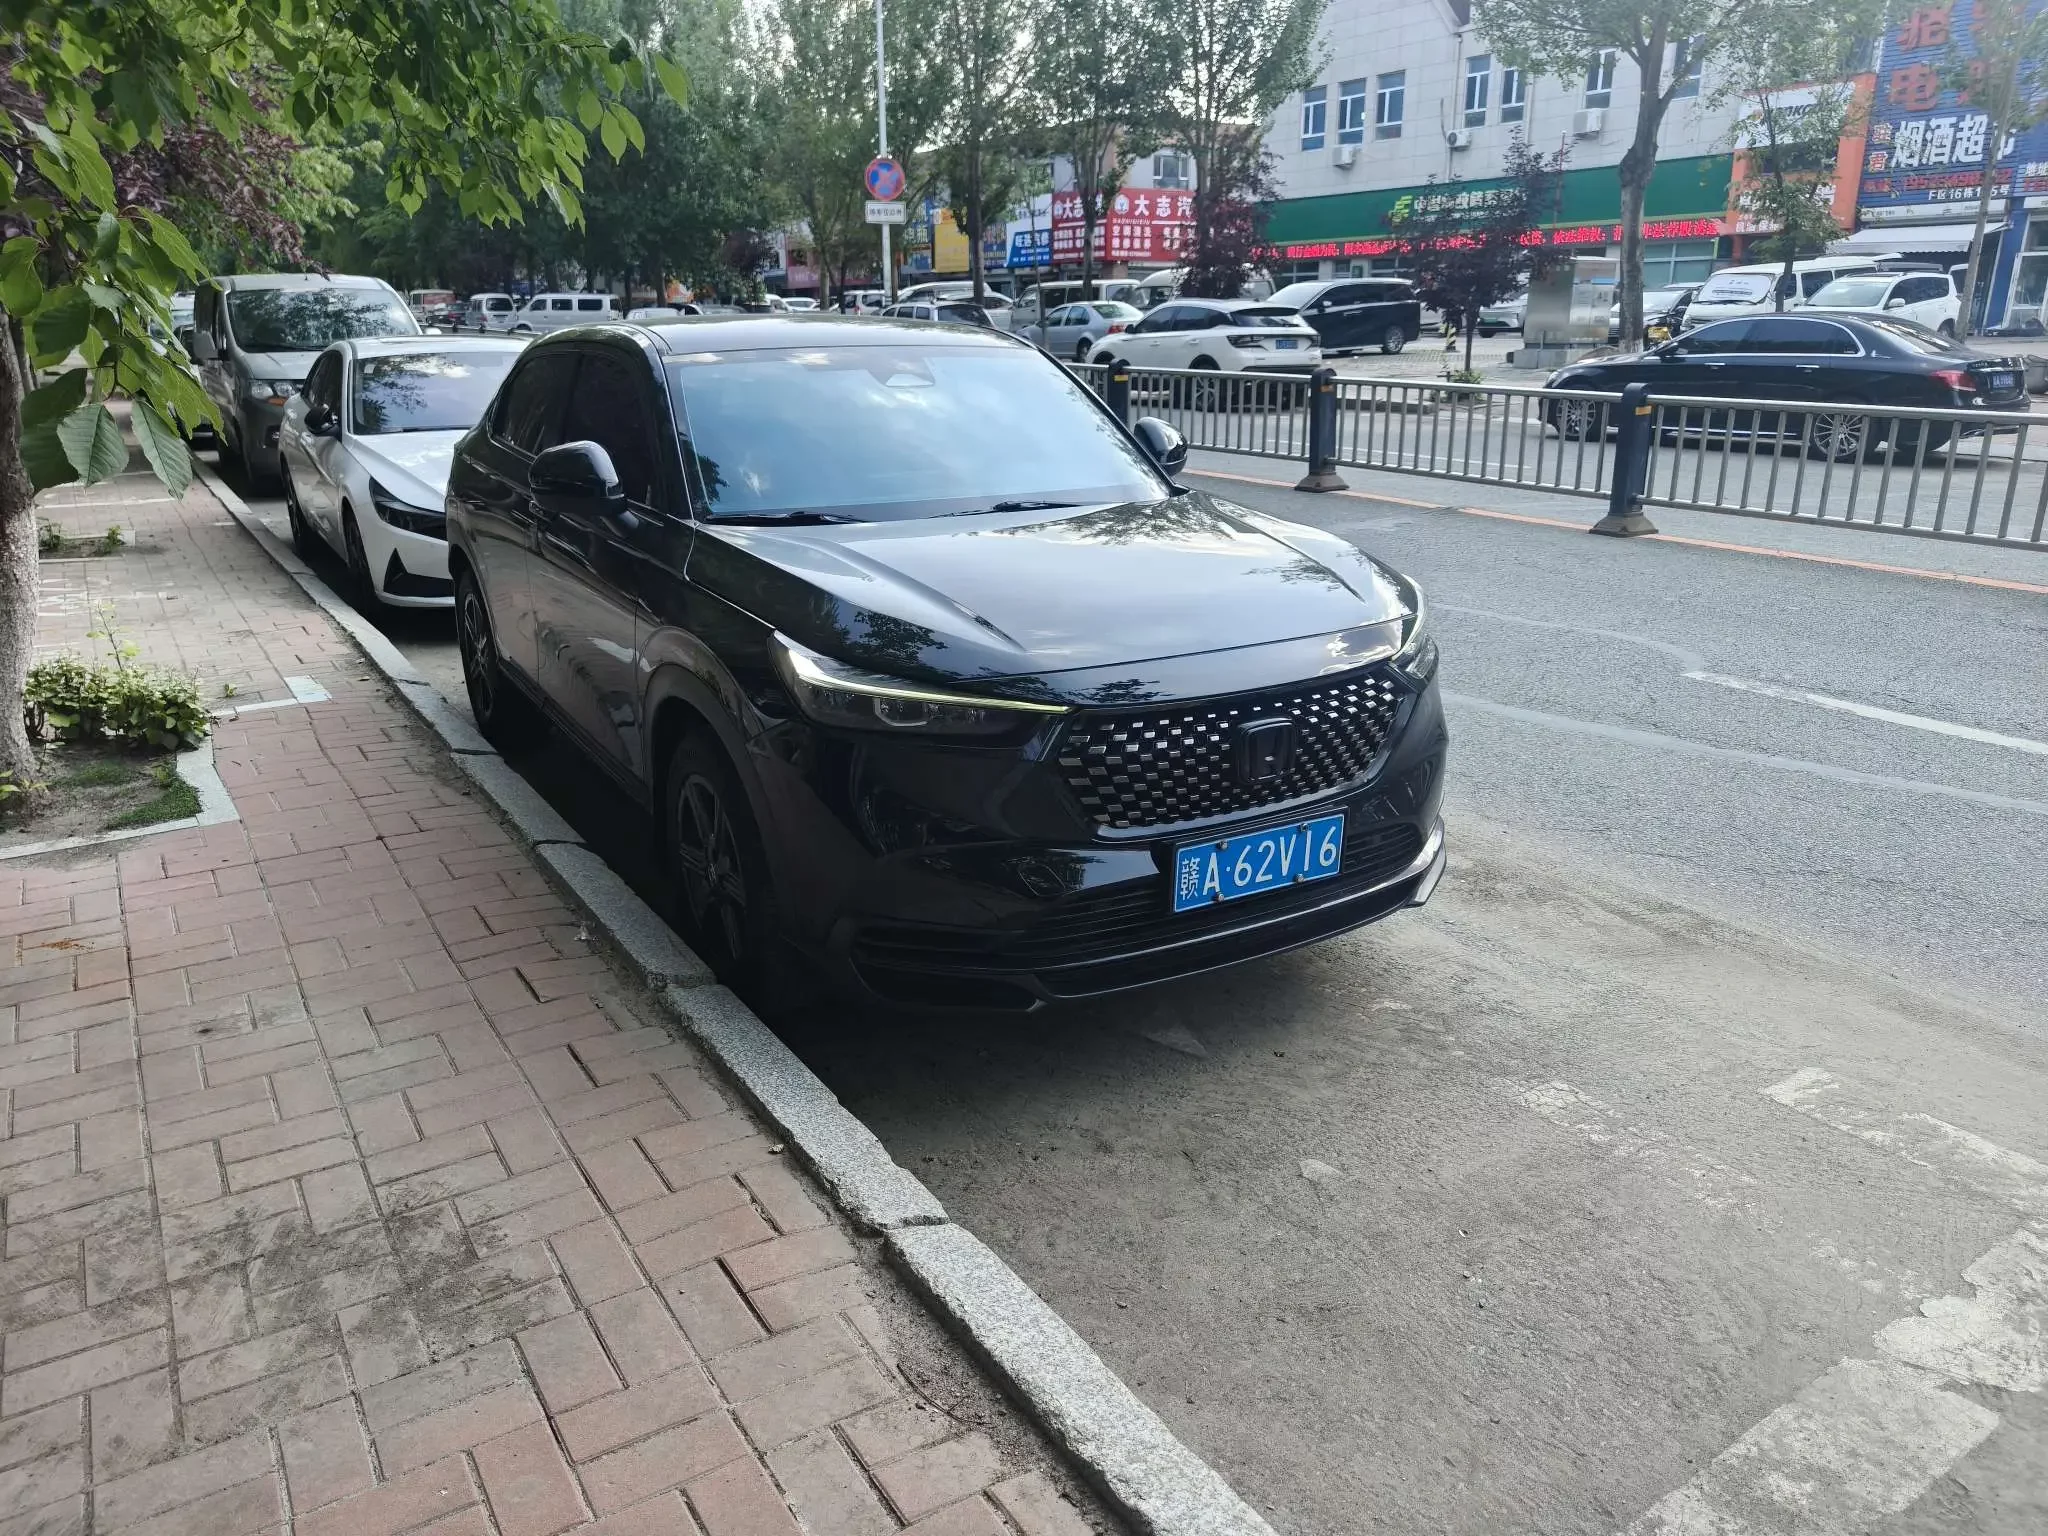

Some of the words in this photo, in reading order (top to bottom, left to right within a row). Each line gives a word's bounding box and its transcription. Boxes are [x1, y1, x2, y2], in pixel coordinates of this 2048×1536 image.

[1928, 185, 2011, 201] F区16栋15号
[1180, 826, 1337, 901] 赣A·62V16
